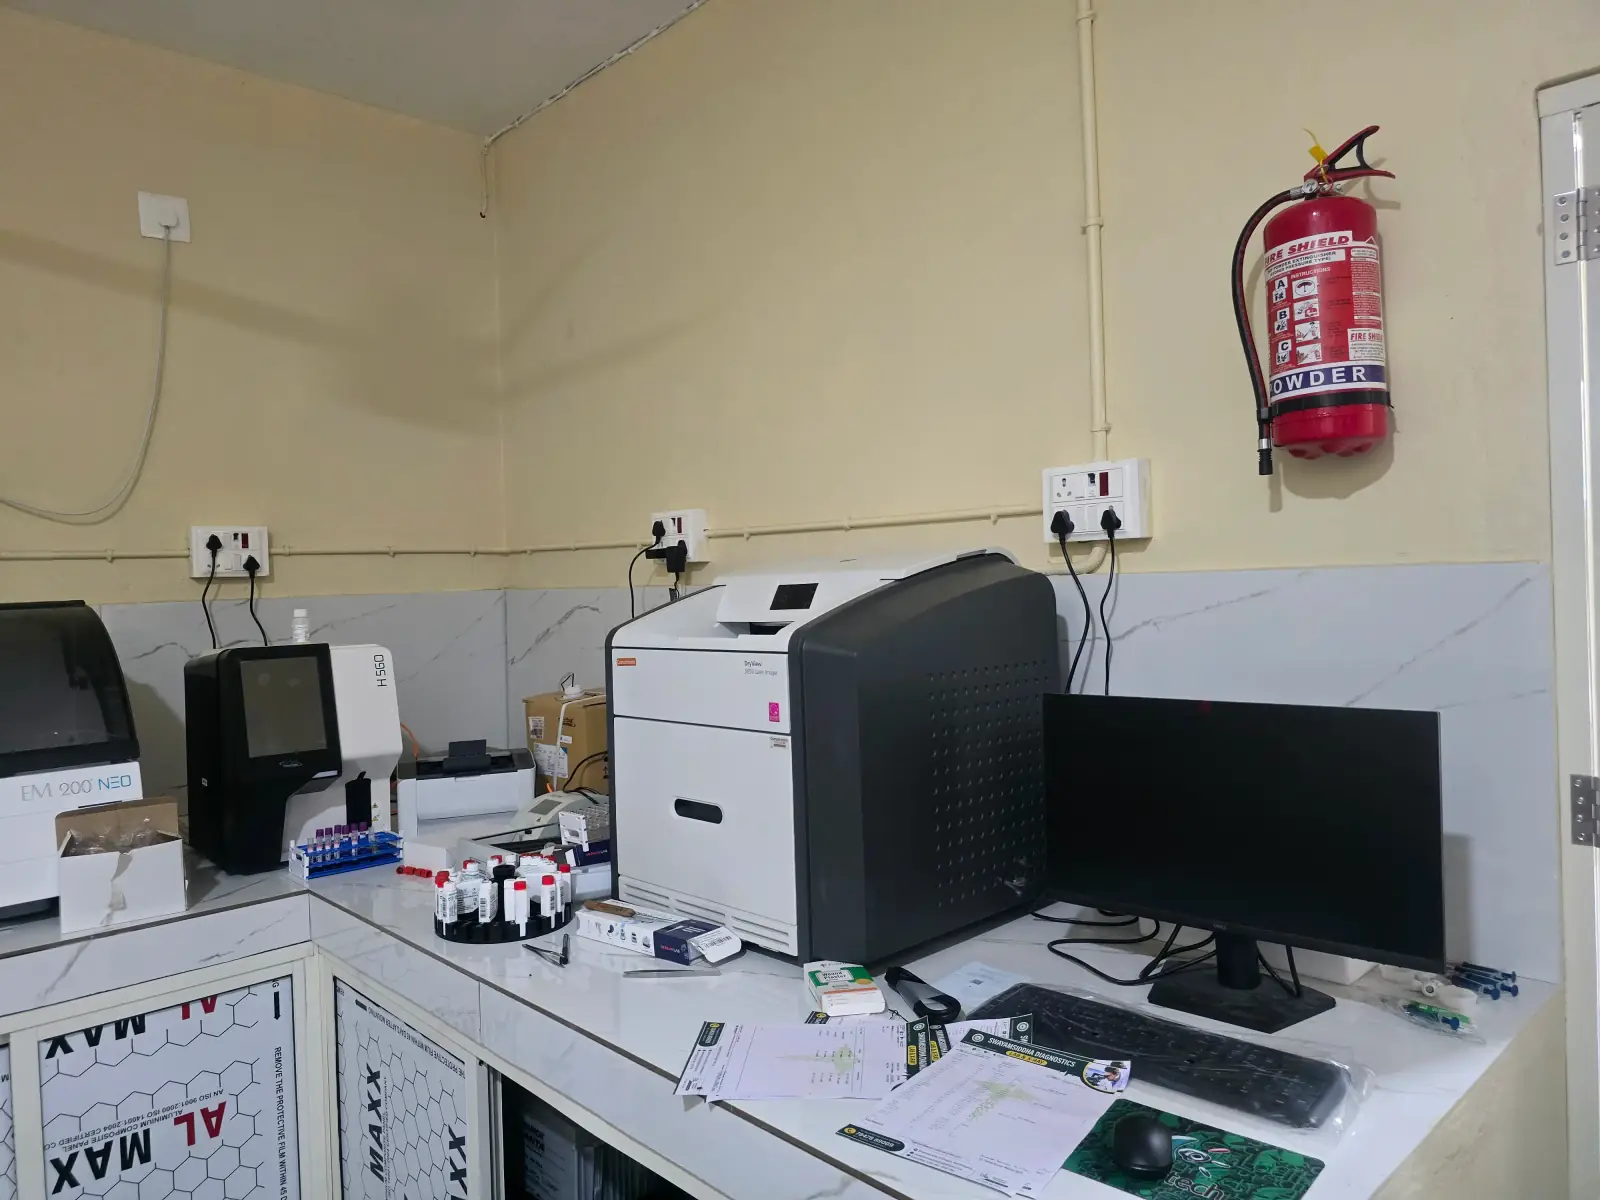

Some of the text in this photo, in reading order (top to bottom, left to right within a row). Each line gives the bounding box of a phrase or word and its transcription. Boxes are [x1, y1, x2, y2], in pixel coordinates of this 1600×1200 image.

[1288, 236, 1349, 255] SHIELD
[1292, 251, 1336, 264] EXTINGUISHER
[1291, 267, 1331, 279] INSTRUCTIONS
[1277, 280, 1285, 289] A
[1280, 310, 1287, 319] B
[1281, 341, 1289, 351] C
[1350, 332, 1366, 341] FIRE
[1271, 366, 1366, 394] OWDER
[373, 654, 387, 687] H 560
[21, 775, 131, 802] EM 200 NEO
[987, 1037, 1077, 1067] SWAYAMSIDDHA DIAGNOSTICS
[274, 1047, 282, 1078] REMOVE
[199, 1093, 212, 1101] ISO
[213, 1089, 224, 1097] AN
[147, 1109, 160, 1118] ISO
[276, 1096, 284, 1140] PROTECTIVE
[366, 1062, 384, 1183] MAXX
[59, 1128, 101, 1146] CERTIFIED
[63, 1109, 183, 1153] ALUMINIUM COMPOSITE PANEL
[50, 1101, 227, 1195] AL MAX
[278, 1159, 286, 1184] WITHIN
[280, 1186, 287, 1194] 45
[1164, 1172, 1224, 1200] tech
